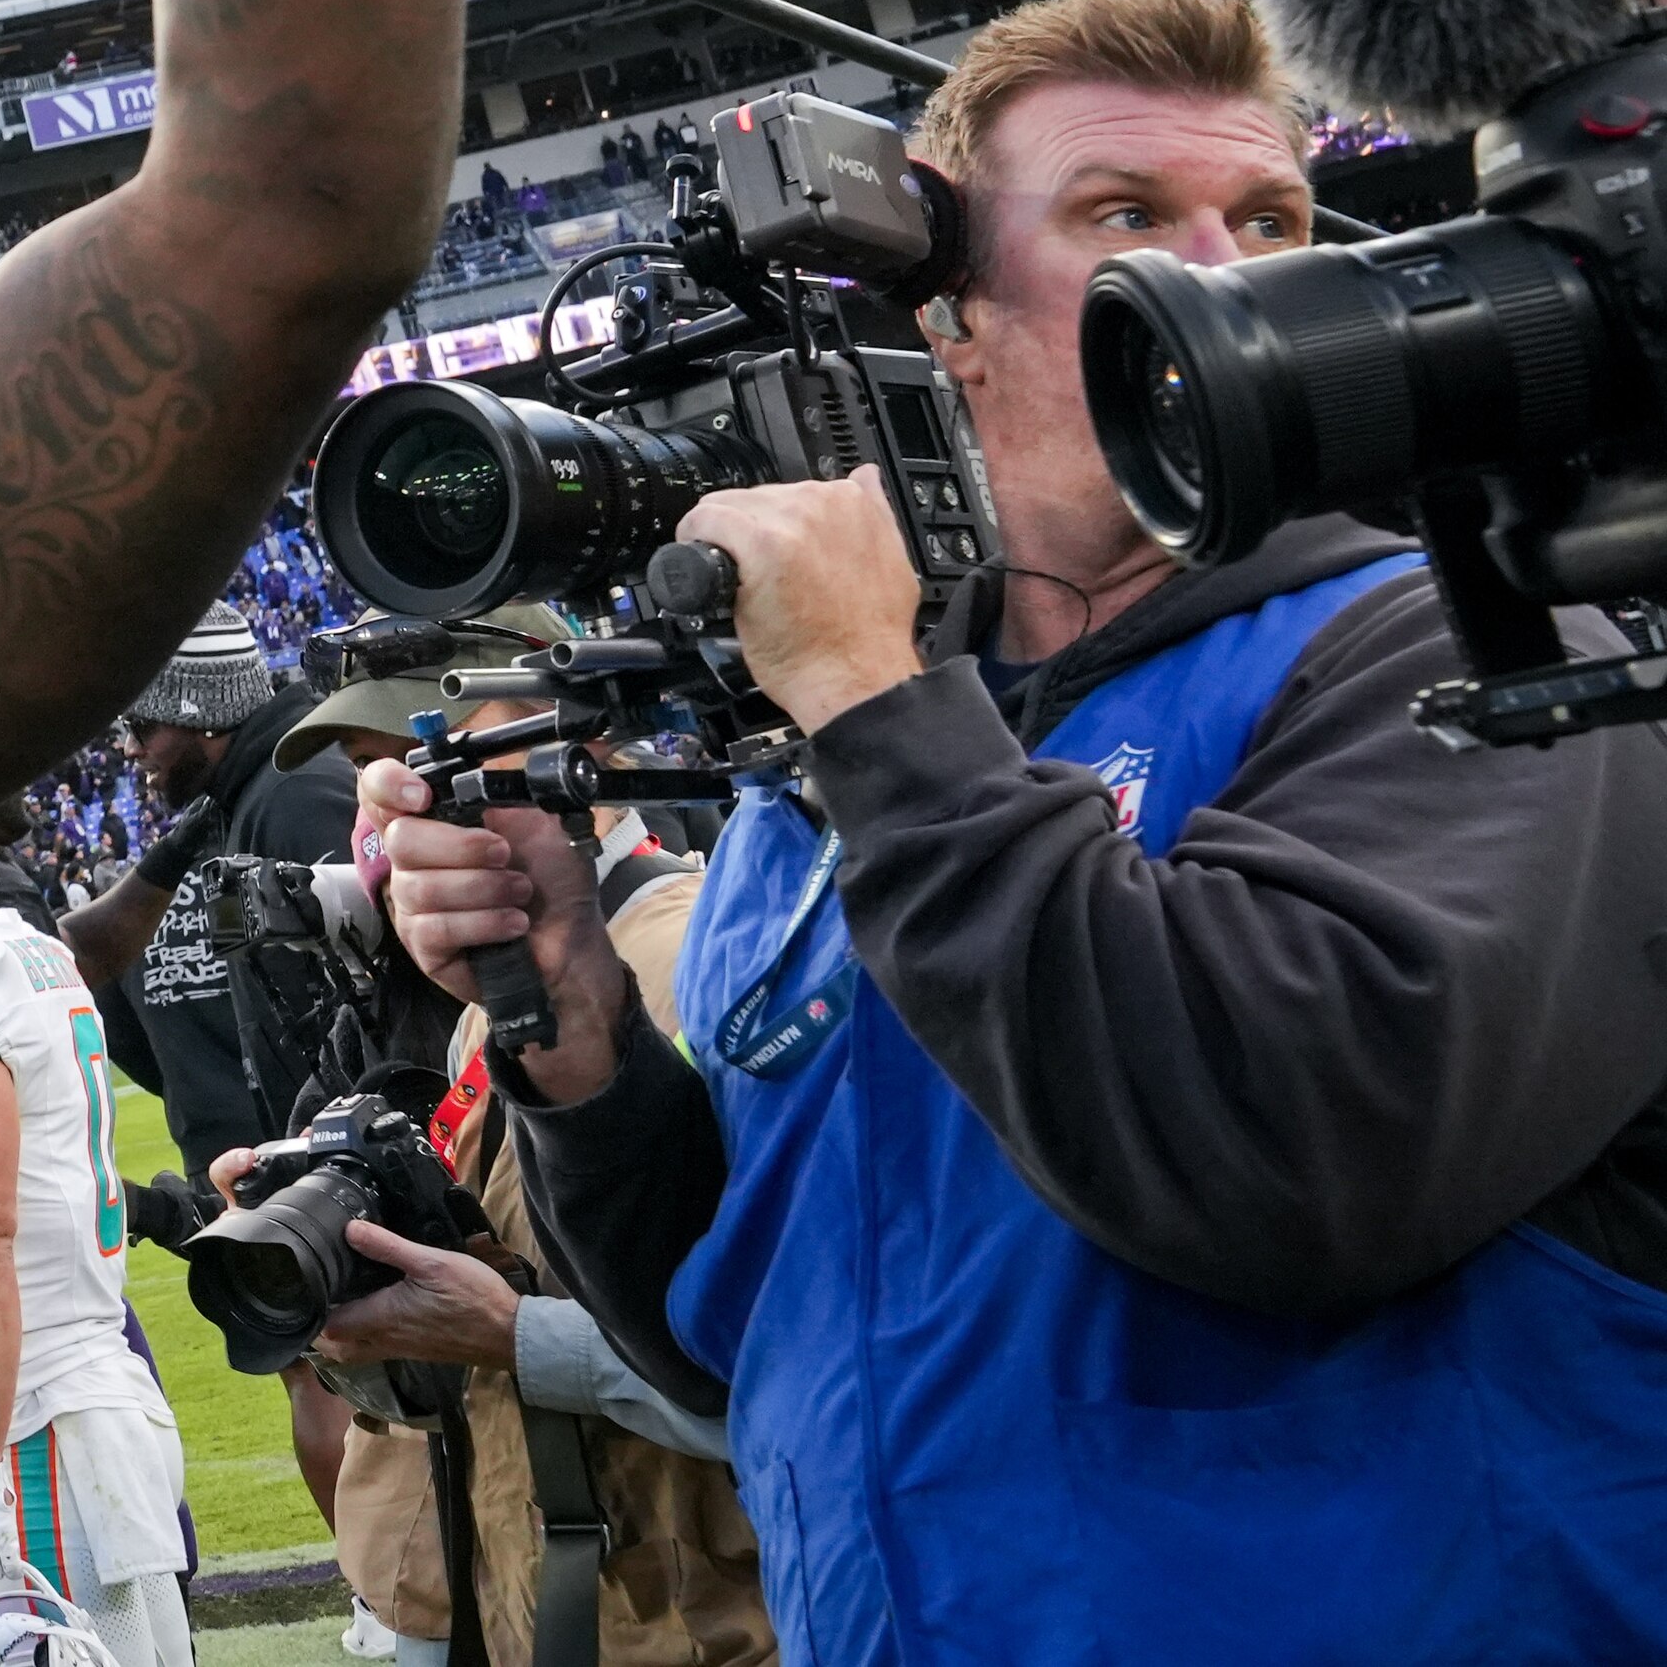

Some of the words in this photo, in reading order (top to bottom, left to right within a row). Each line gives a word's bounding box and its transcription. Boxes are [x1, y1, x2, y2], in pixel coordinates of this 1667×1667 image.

[827, 151, 883, 186] AMIRA
[730, 984, 767, 1035] LEAGUE
[740, 1024, 802, 1073] NATIONAL
[312, 1130, 348, 1144] Nikon
